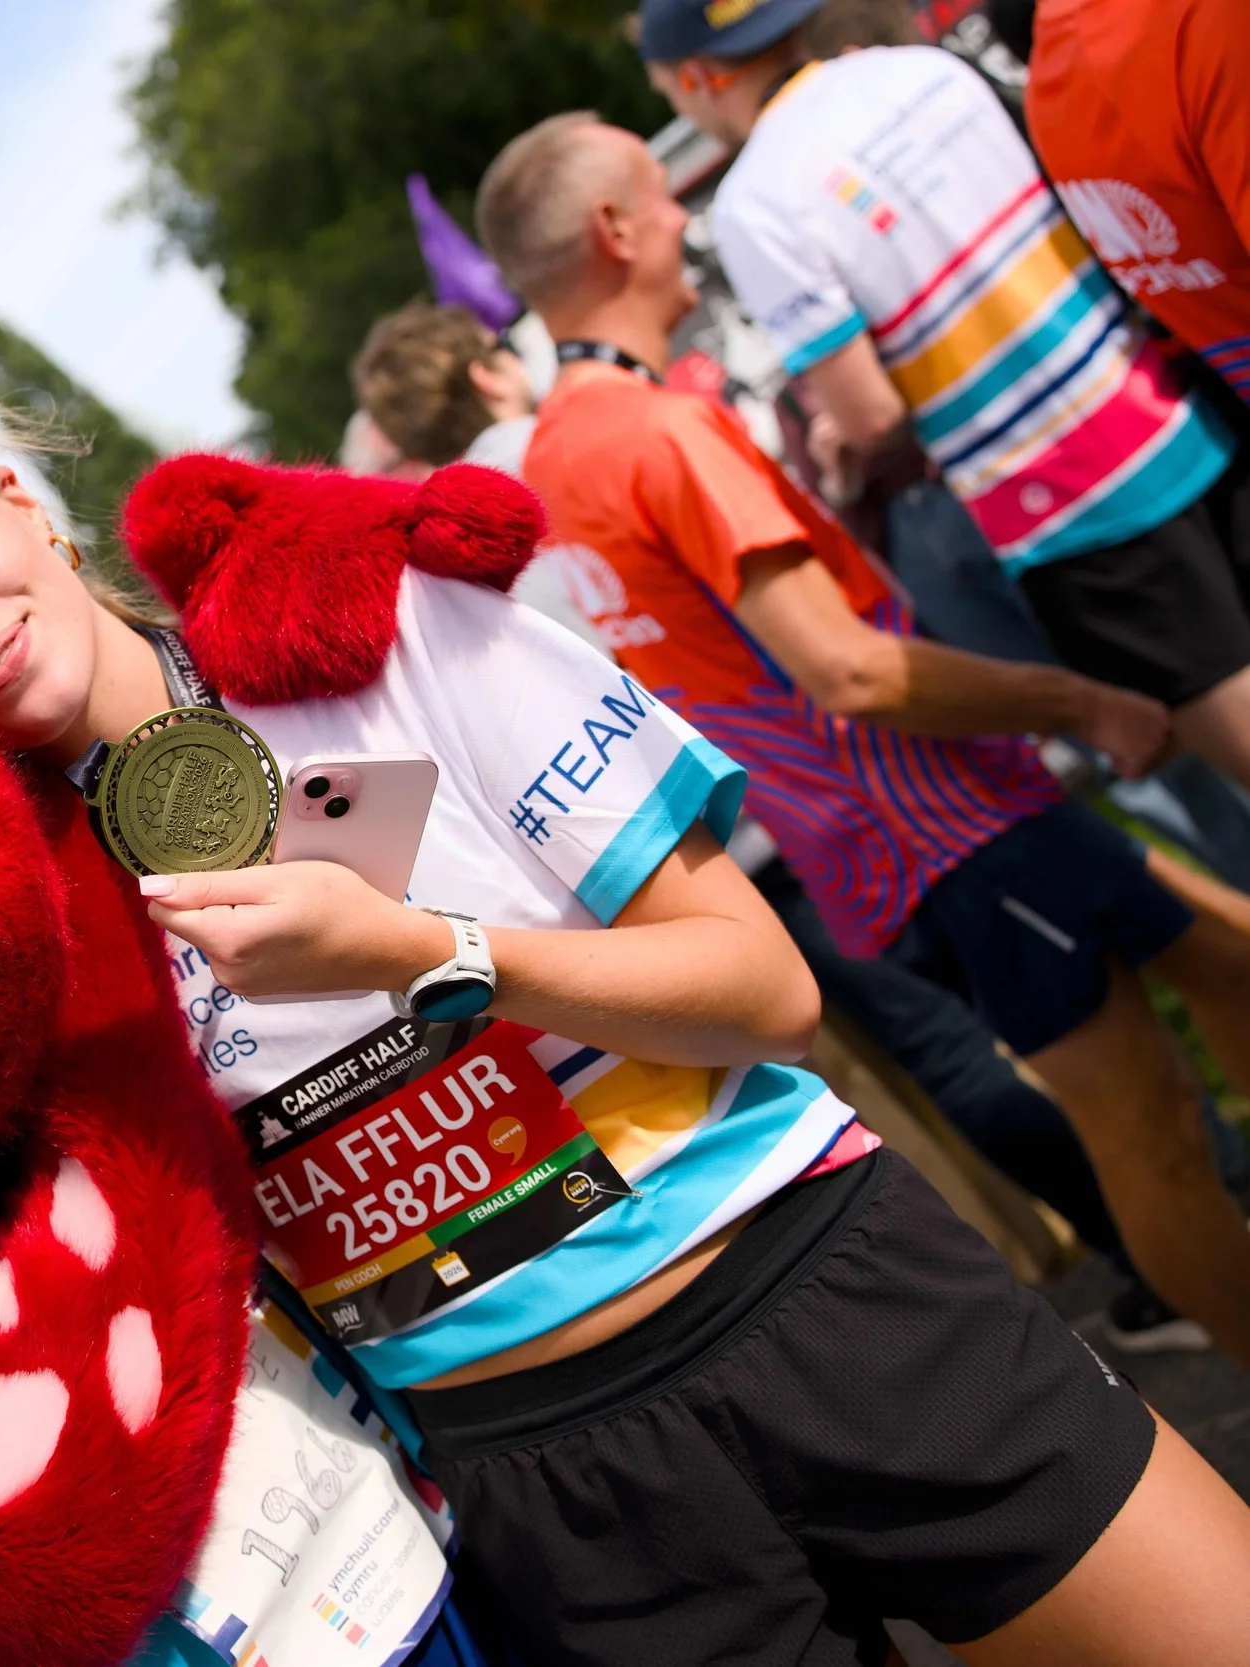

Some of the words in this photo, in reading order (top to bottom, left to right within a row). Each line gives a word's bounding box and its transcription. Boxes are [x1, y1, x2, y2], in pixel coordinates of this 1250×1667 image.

[183, 668, 212, 706] HALF
[509, 674, 656, 846] #TEAM
[197, 1029, 258, 1078] les
[281, 1058, 360, 1116] CARDIFF
[359, 1023, 416, 1071] HALF
[294, 1104, 332, 1130] HANNER
[330, 1075, 381, 1110] MARATHON
[379, 1046, 430, 1082] CAERDYDD
[253, 1157, 346, 1228] ELA
[335, 1054, 517, 1183] FFLUR
[493, 1124, 522, 1147] Cymraeg
[326, 1144, 491, 1262] 25820
[467, 1190, 516, 1223] FEMALE
[513, 1163, 558, 1196] SMALL
[334, 1276, 355, 1293] PEN
[353, 1263, 383, 1285] COCH
[442, 1264, 463, 1280] 2026
[331, 1303, 361, 1329] RAW
[241, 1425, 358, 1588] 1966
[327, 1532, 378, 1594] ymchwil
[342, 1560, 380, 1605] cymru
